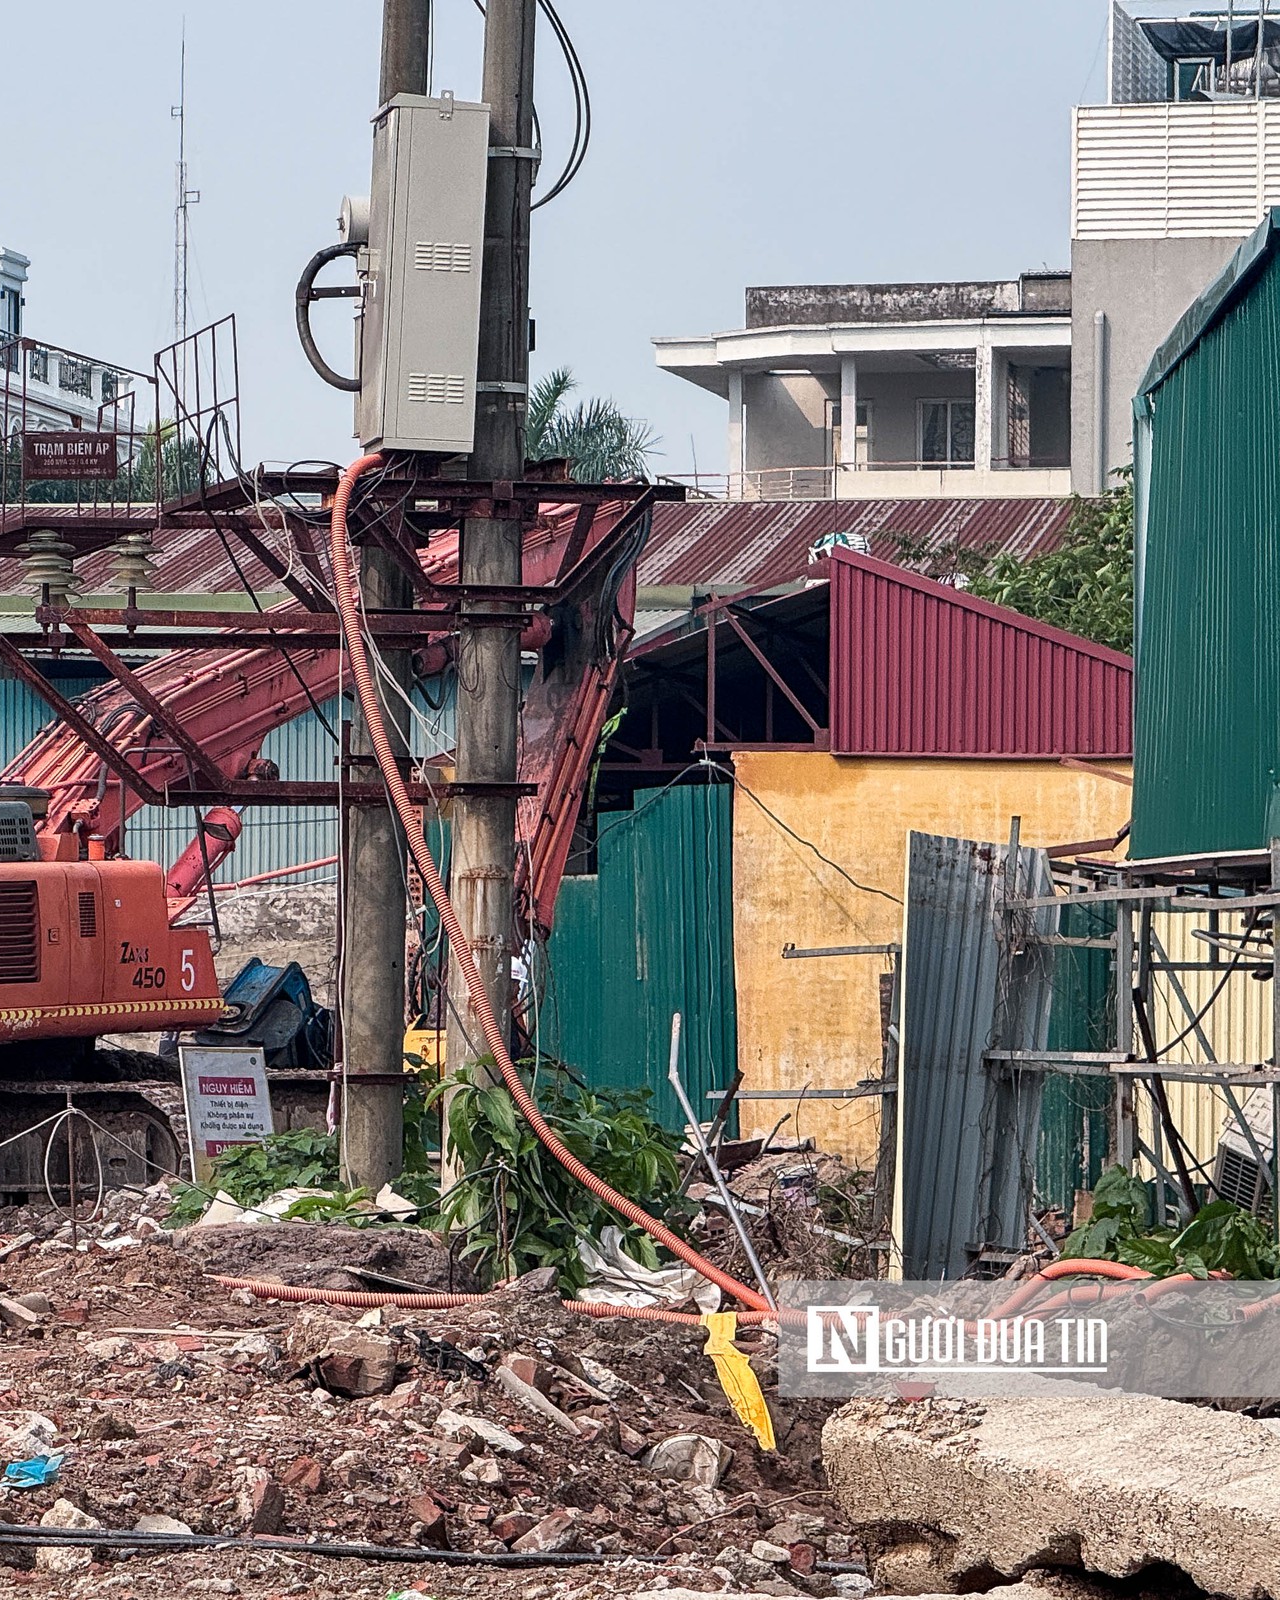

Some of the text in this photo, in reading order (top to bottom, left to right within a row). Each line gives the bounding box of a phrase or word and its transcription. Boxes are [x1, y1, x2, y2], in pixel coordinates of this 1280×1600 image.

[33, 439, 110, 458] TRẠM BIẾN ÁP
[132, 967, 166, 989] 450
[181, 949, 195, 991] 5
[202, 1079, 253, 1095] NGUY HIỂM
